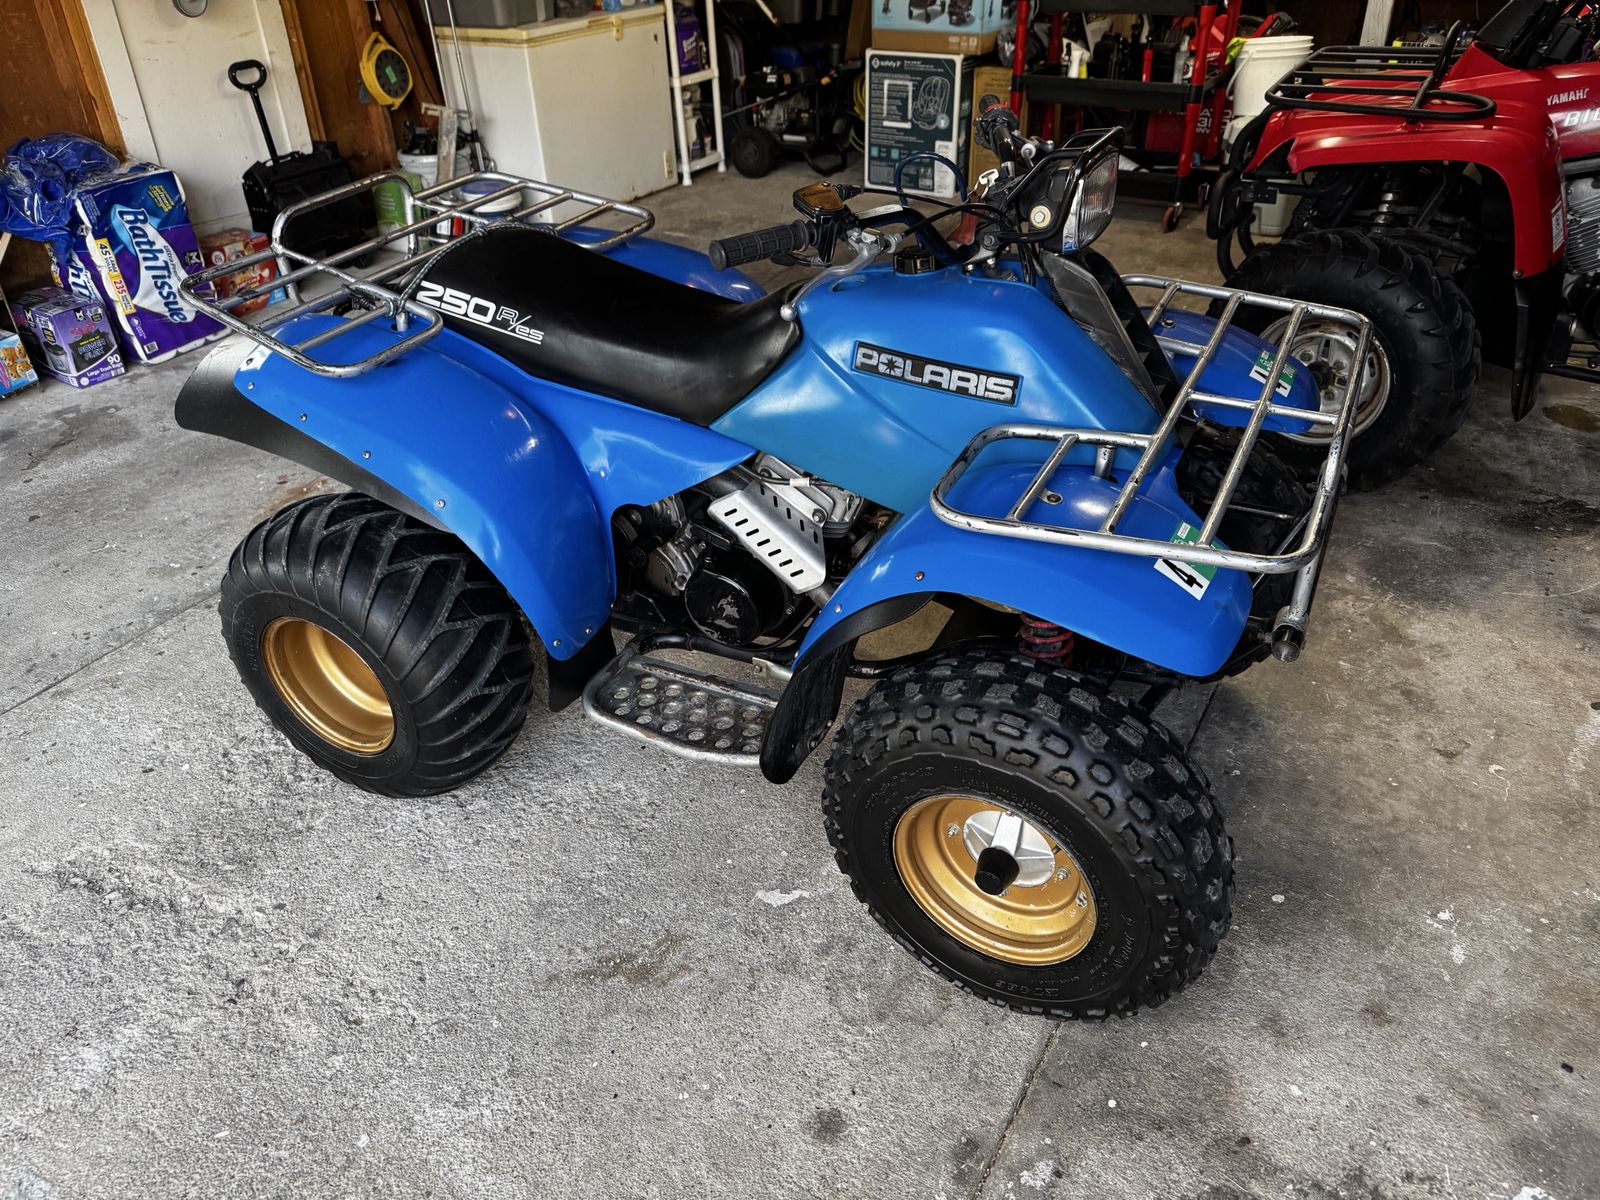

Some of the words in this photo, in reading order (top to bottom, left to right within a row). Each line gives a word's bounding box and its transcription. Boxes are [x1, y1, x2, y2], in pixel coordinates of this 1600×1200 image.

[98, 243, 111, 257] 45
[113, 279, 127, 296] 235
[416, 280, 497, 324] 250
[107, 354, 121, 365] 90
[86, 368, 101, 378] Large
[100, 364, 113, 374] Trash
[854, 346, 1016, 401] POLARIS
